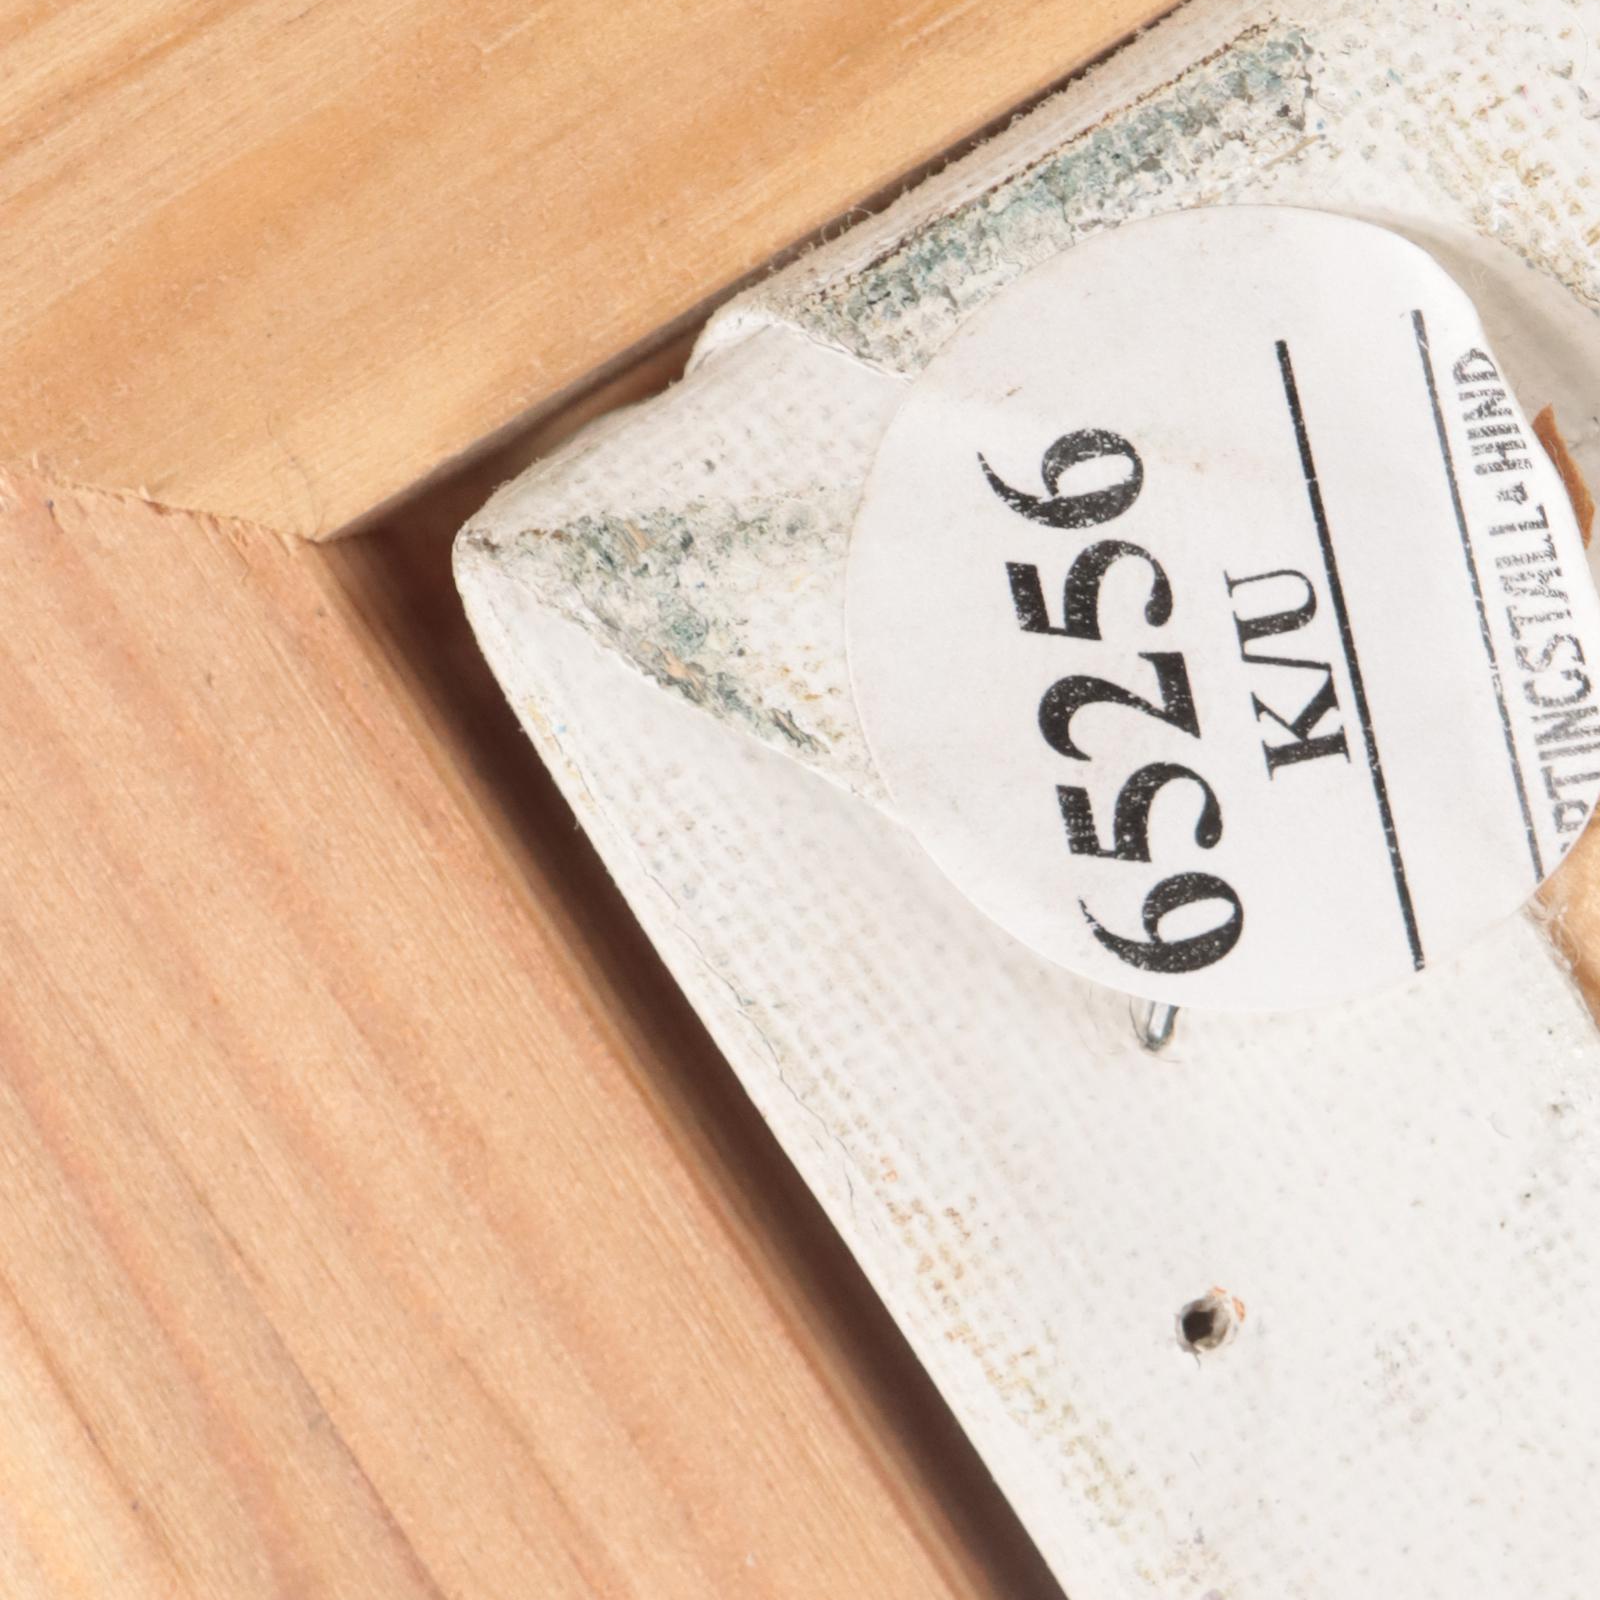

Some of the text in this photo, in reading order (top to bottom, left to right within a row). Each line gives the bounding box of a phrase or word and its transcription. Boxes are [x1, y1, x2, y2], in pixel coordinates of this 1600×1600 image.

[1451, 346, 1534, 477] HIND
[975, 426, 1245, 975] 65256
[1222, 567, 1352, 781] K/U
